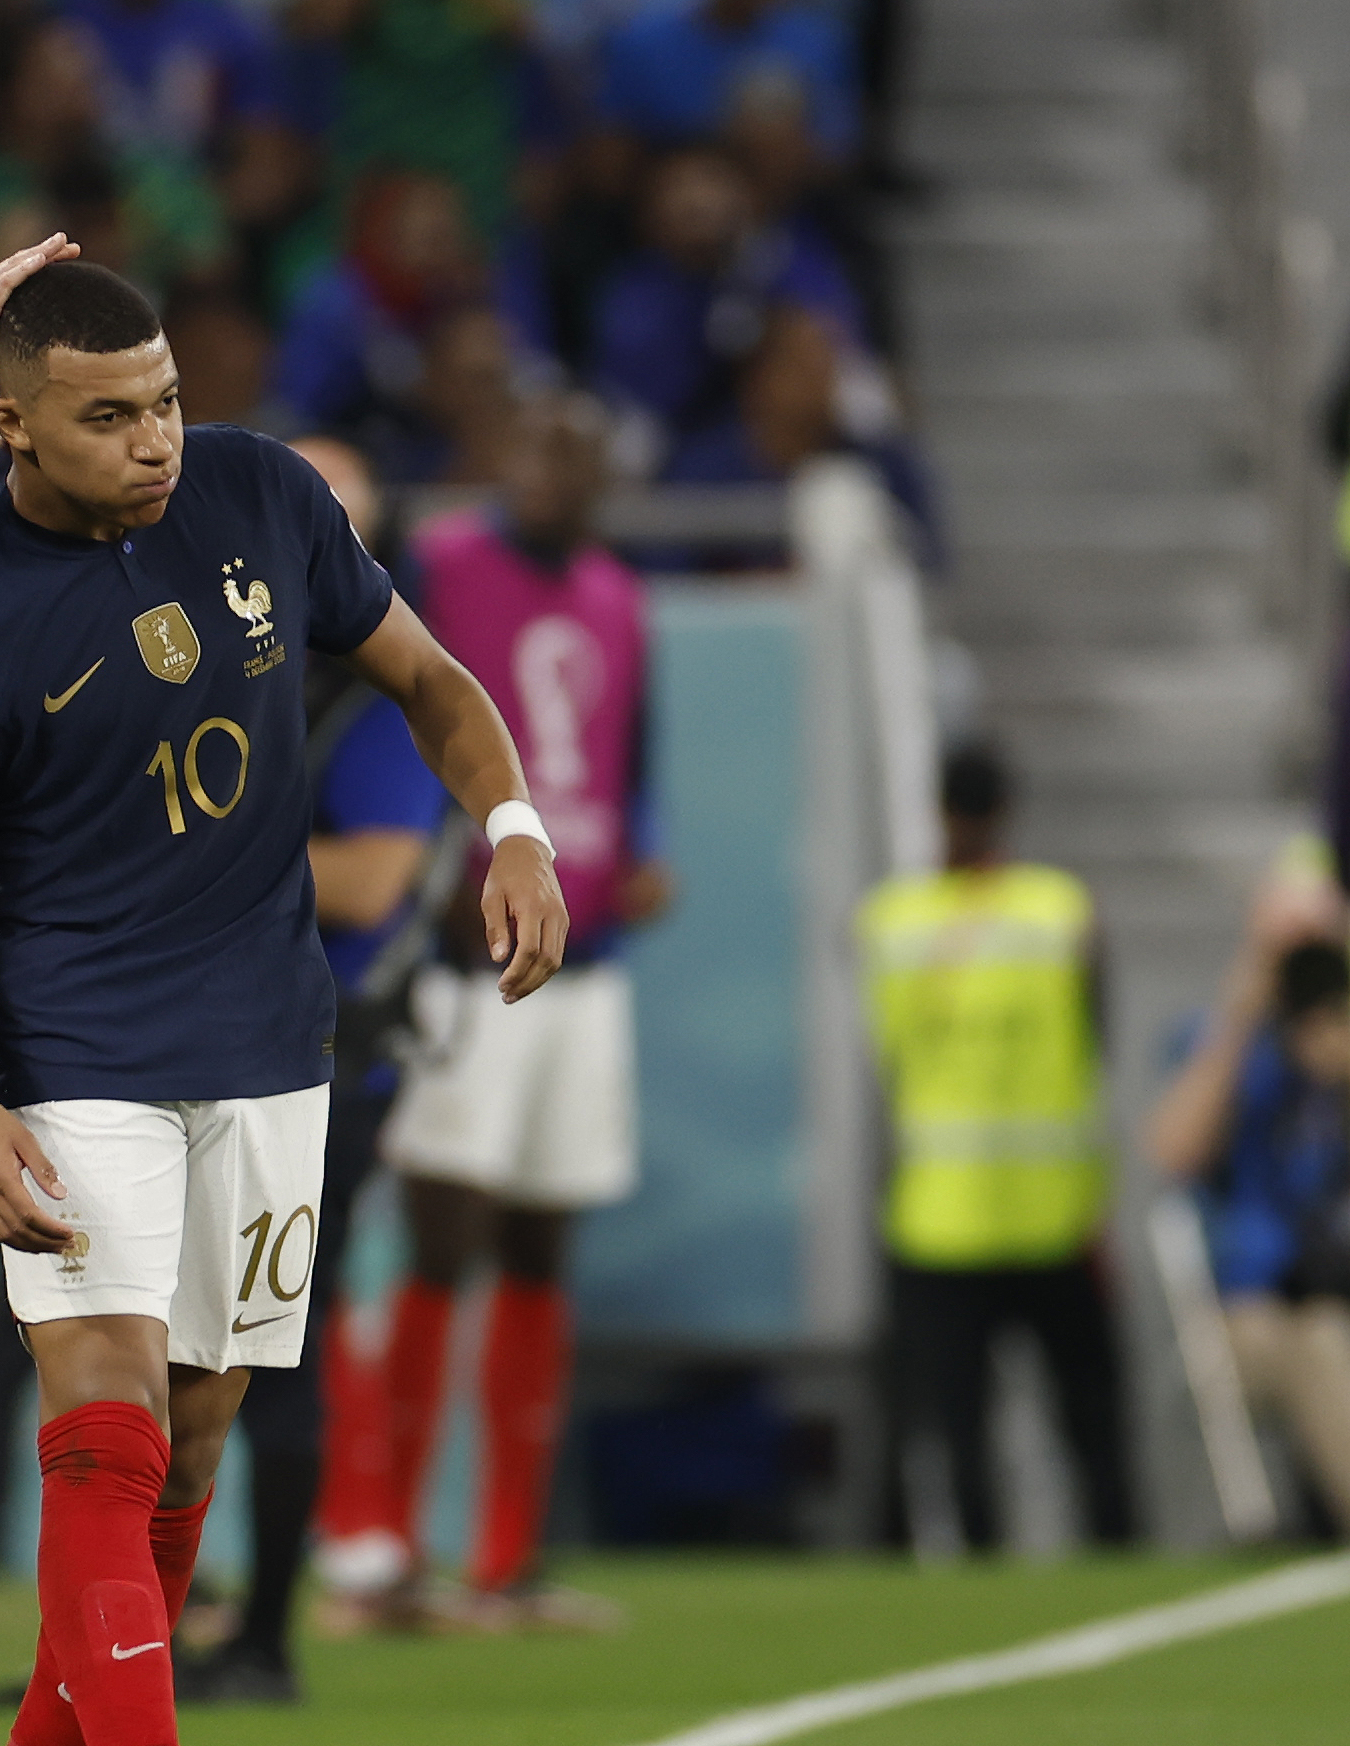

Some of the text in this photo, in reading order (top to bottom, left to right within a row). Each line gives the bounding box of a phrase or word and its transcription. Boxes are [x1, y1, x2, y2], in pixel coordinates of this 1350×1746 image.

[163, 651, 187, 668] FIFA
[145, 717, 249, 834] 10
[238, 1204, 316, 1302] 10
